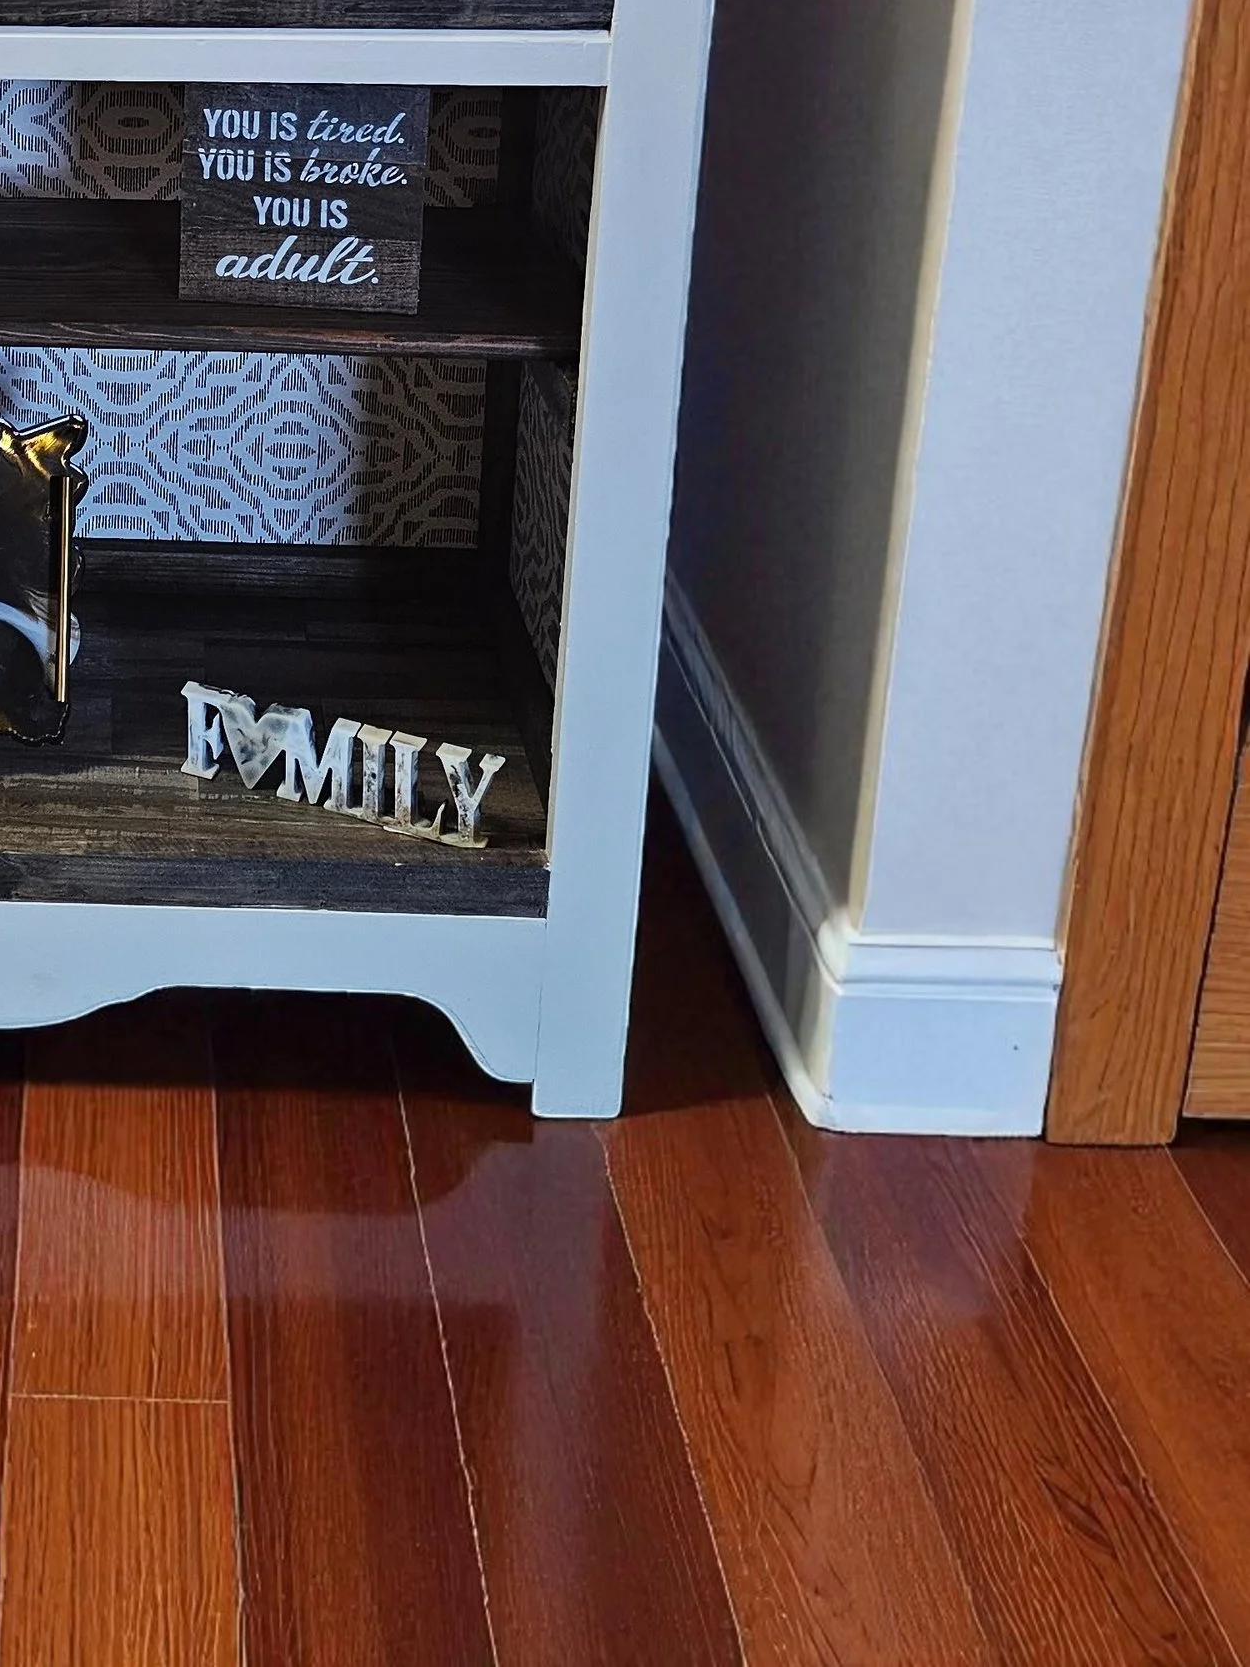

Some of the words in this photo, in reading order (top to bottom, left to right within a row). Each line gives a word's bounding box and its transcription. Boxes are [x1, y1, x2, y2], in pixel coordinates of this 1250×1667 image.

[203, 108, 261, 140] YOU
[269, 111, 299, 142] IS
[306, 110, 406, 145] tired.
[197, 147, 255, 181] YOU
[263, 150, 292, 183] IS
[299, 147, 408, 187] broke.
[253, 196, 311, 226] YOU
[319, 199, 349, 230] IS
[215, 235, 380, 285] adult.
